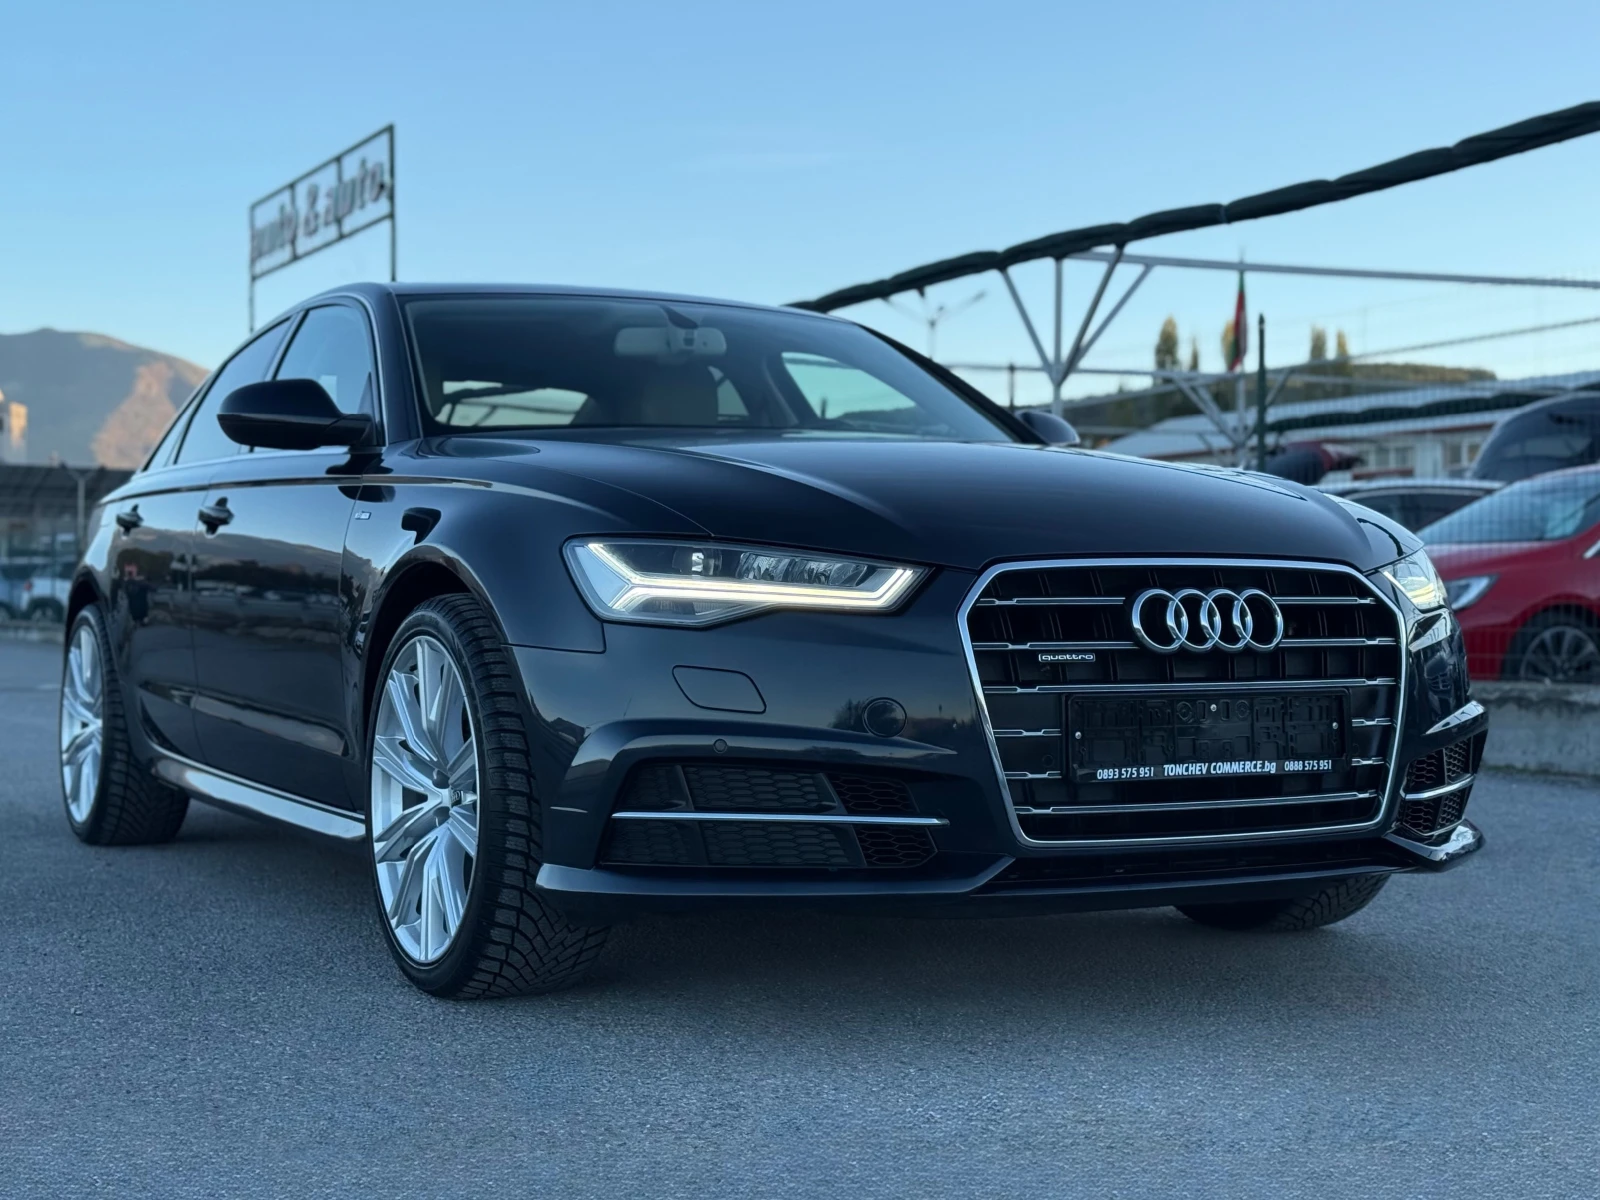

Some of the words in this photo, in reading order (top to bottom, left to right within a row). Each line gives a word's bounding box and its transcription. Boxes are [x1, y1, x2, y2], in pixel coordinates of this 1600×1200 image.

[1042, 653, 1094, 661] quattro
[1096, 768, 1119, 780] 0893
[1121, 767, 1138, 779] 575
[1139, 766, 1154, 777] 951
[1163, 762, 1209, 776] TONCHEV
[1210, 760, 1277, 774] COMMERCE.bg
[1284, 760, 1303, 771] 0888
[1304, 760, 1318, 771] 575
[1319, 759, 1332, 770] 951
